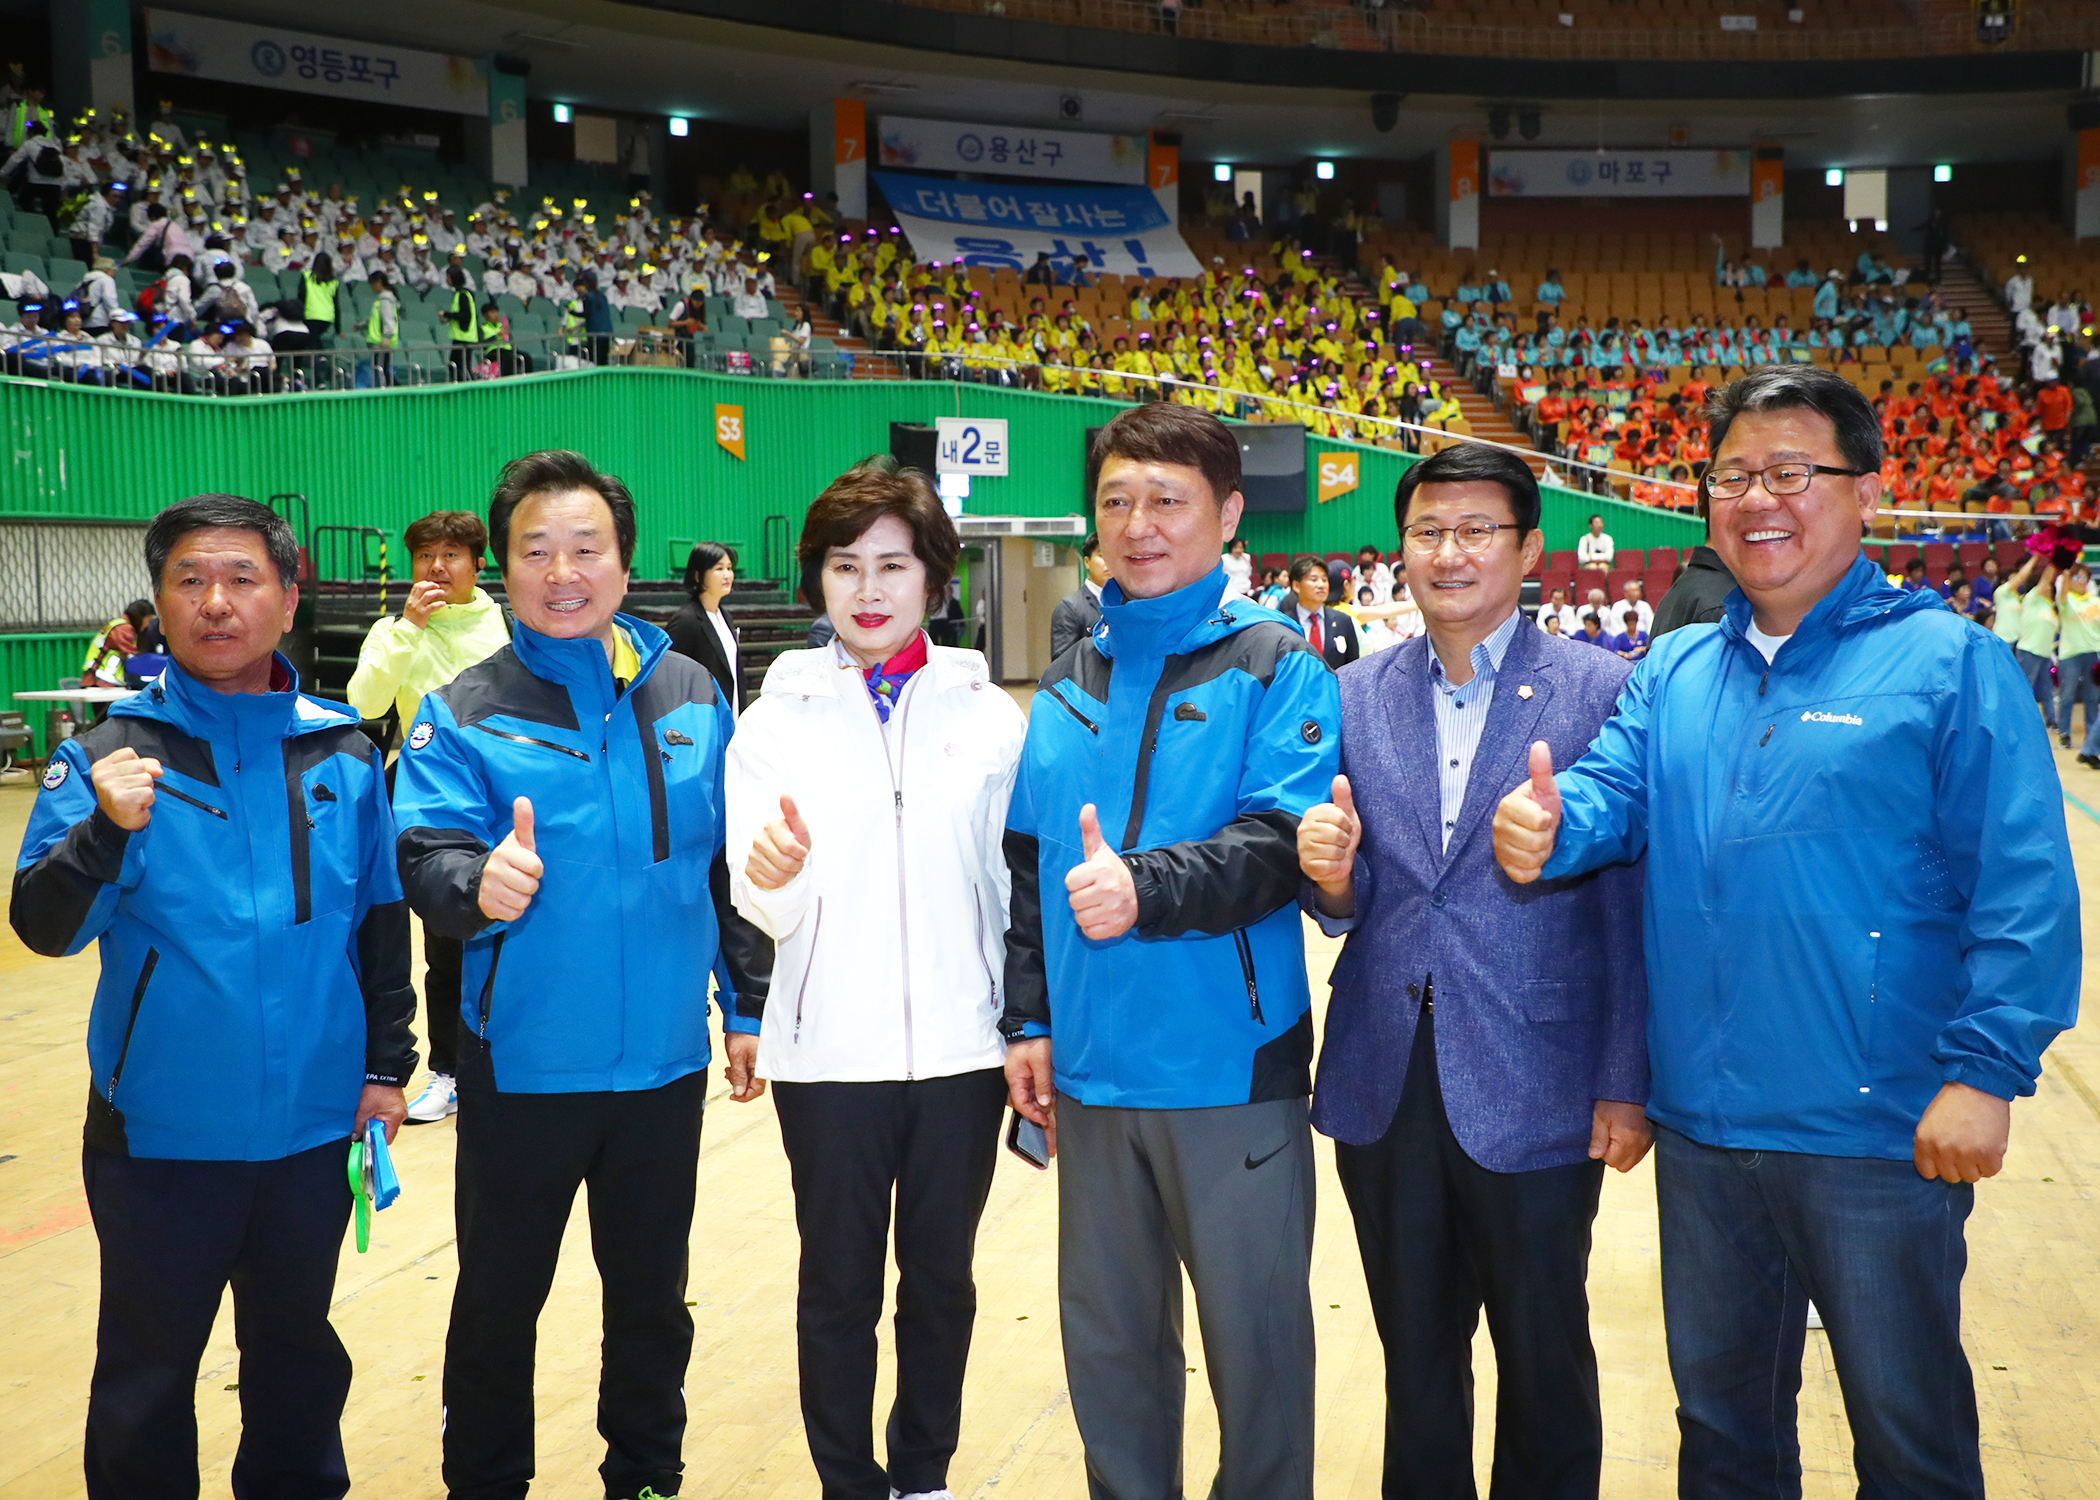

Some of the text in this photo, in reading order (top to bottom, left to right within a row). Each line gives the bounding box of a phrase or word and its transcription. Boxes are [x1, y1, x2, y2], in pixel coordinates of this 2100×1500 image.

[101, 30, 121, 57] 6
[290, 45, 400, 89] 영등포구
[501, 99, 518, 124] 6
[843, 138, 857, 161] 7
[989, 136, 1064, 167] 용산구
[1157, 165, 1171, 187] 7
[1598, 160, 1672, 186] 마포구
[1457, 177, 1471, 200] 8
[916, 190, 1024, 221] 더불어
[1026, 201, 1127, 228] 잘사는
[719, 415, 742, 441] S3
[1321, 462, 1355, 486] S4
[1810, 711, 1863, 726] Columbia
